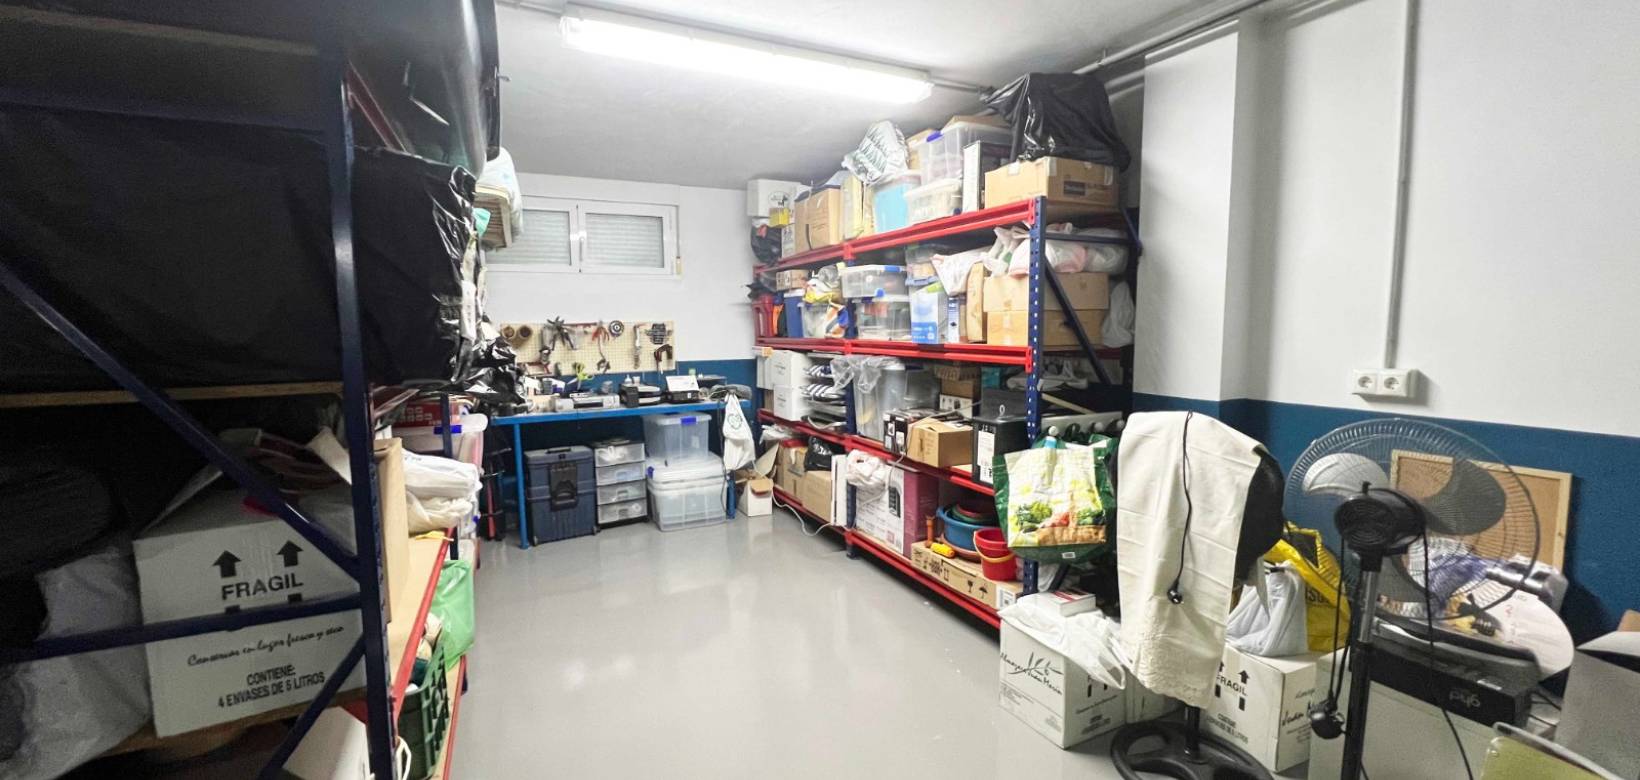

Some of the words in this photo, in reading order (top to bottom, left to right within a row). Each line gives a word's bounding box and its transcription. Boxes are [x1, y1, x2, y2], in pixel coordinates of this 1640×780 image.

[221, 573, 304, 600] FRAGIL
[246, 664, 296, 686] CONTIENE:
[217, 697, 225, 708] 4
[226, 686, 271, 707] ENVASES
[271, 682, 284, 696] DE
[294, 672, 325, 688] LITROS
